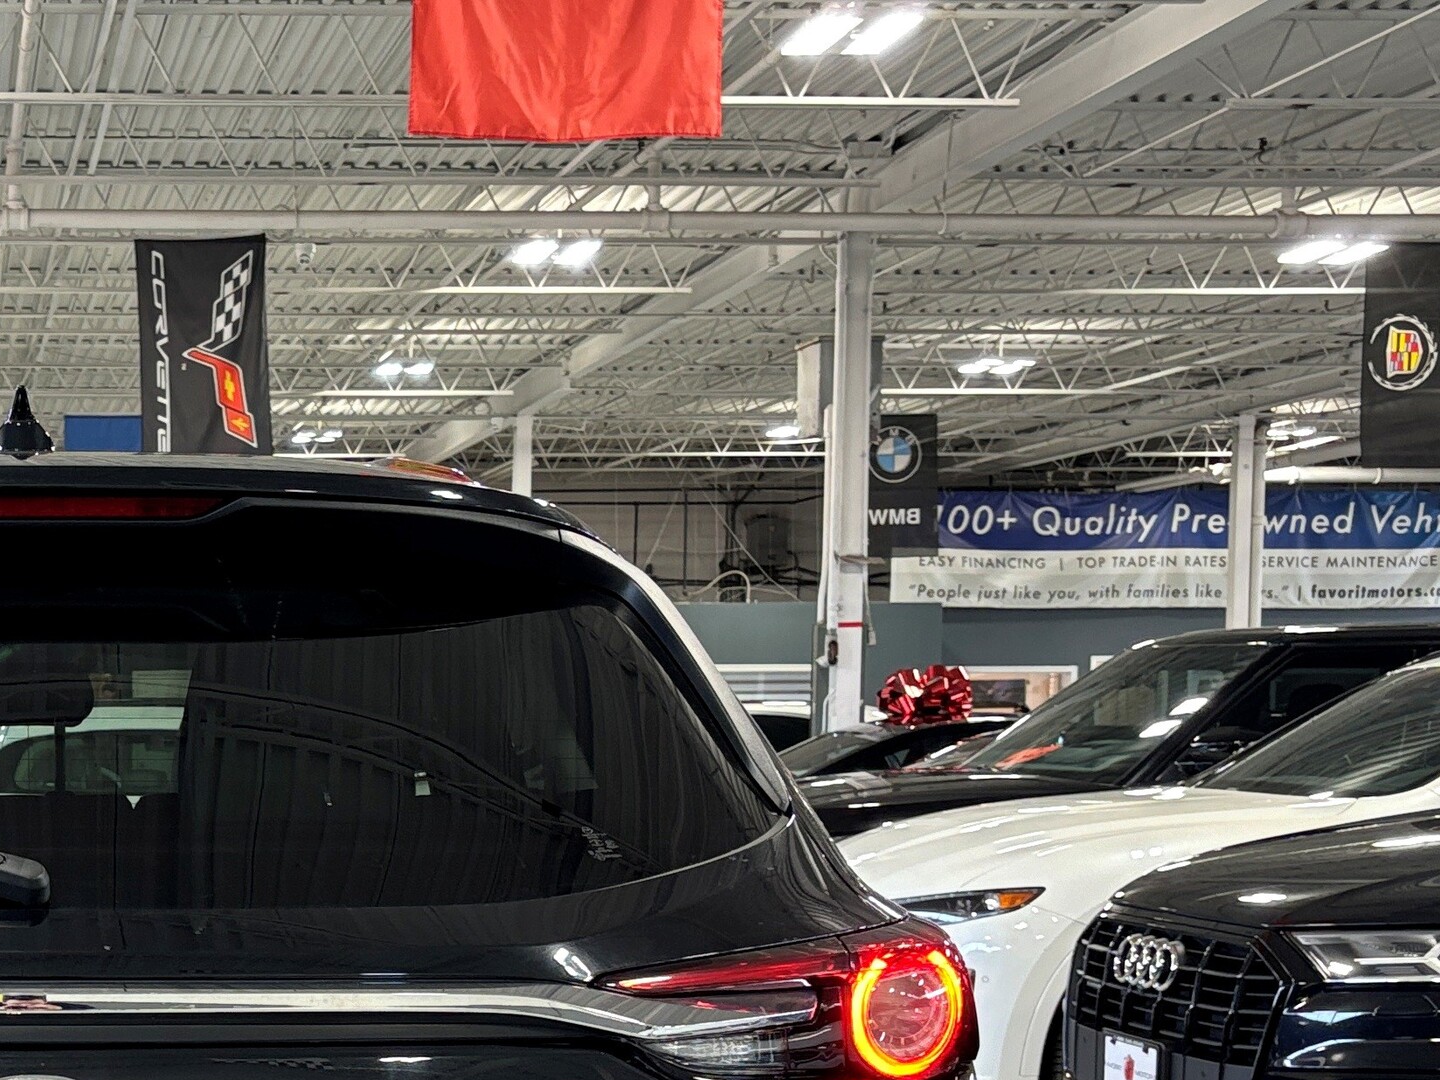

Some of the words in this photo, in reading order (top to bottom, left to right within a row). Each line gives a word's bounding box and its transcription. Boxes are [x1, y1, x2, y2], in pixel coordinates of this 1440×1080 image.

[151, 250, 171, 453] CORVETTE
[1032, 503, 1158, 543] Quality
[918, 555, 955, 567] EASY
[961, 554, 1046, 569] FINANCING
[1077, 556, 1107, 569] TOP
[1112, 555, 1177, 568] TRADE-IN
[1184, 555, 1227, 568] RATES
[1261, 555, 1319, 568] SERVICE
[1325, 554, 1438, 569] MAINTENANCE
[977, 586, 1006, 601] just
[1012, 583, 1042, 600] like
[1047, 589, 1080, 604] you,
[1088, 585, 1120, 600] with
[1126, 583, 1190, 599] families
[1195, 582, 1224, 599] like
